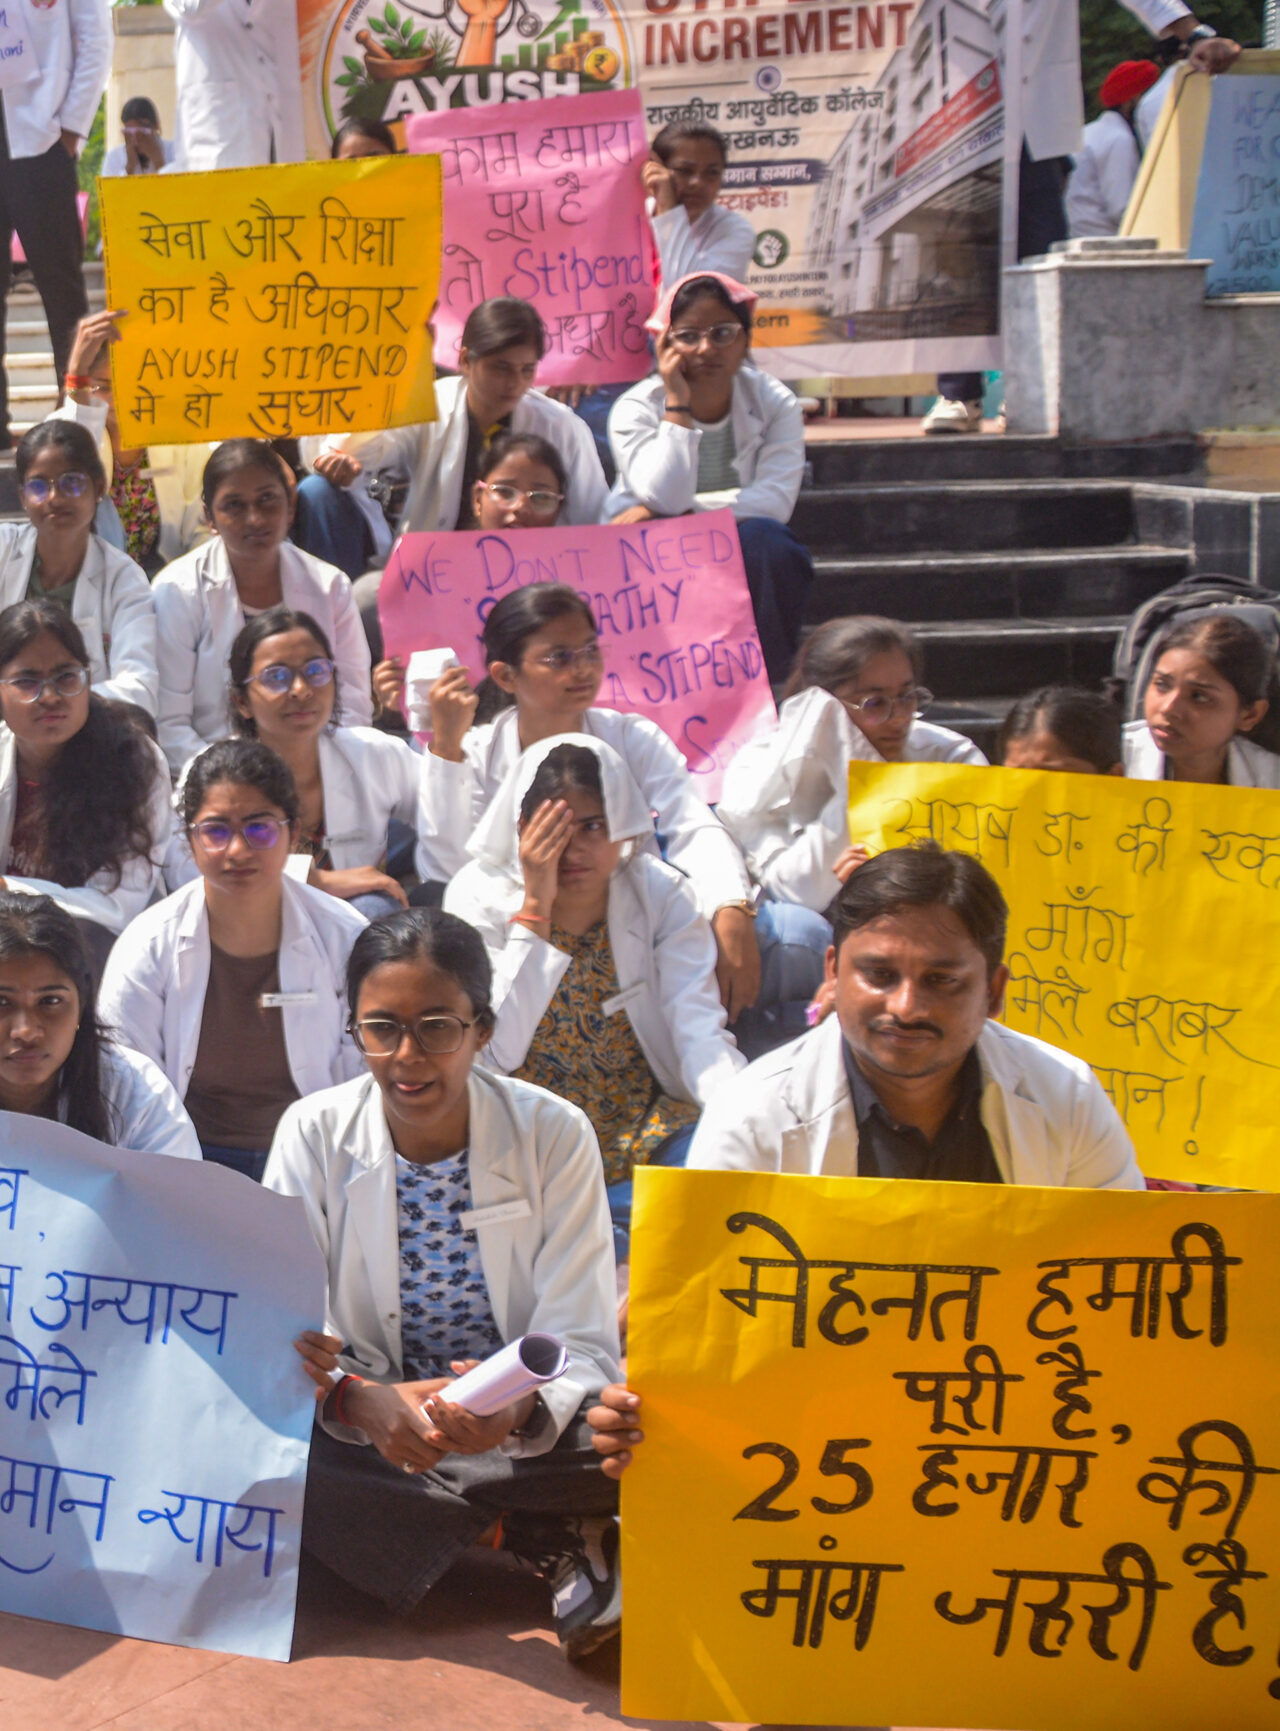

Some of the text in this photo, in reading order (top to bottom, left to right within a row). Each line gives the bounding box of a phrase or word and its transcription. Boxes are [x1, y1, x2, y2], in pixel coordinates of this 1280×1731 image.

[645, 2, 916, 66] INCREMENT
[380, 70, 580, 123] AYUSH
[646, 87, 887, 126] राजकीय आयुर्वेदिक कॉलेज
[441, 120, 636, 186] काम हमारा
[139, 196, 406, 266] सेवा और शिक्षा
[486, 171, 589, 243] पूरा है
[443, 214, 650, 311] तो Stipend
[139, 270, 418, 335] का है अधिकार
[137, 342, 408, 382] AYUSH STIPEND
[184, 384, 223, 429] हो
[248, 385, 362, 438] सुधार
[396, 529, 734, 596] WE DON'T NEED
[1117, 797, 1174, 877] की
[1002, 951, 1280, 1070] मिले बराबर
[29, 1270, 238, 1356] अन्याय
[719, 1210, 1244, 1349] मेहनत हमारी
[892, 1343, 1025, 1436] पूरी
[731, 1418, 1280, 1539] 25 हजार की
[137, 1489, 286, 1578] न्याय
[739, 1534, 905, 1652] मांग
